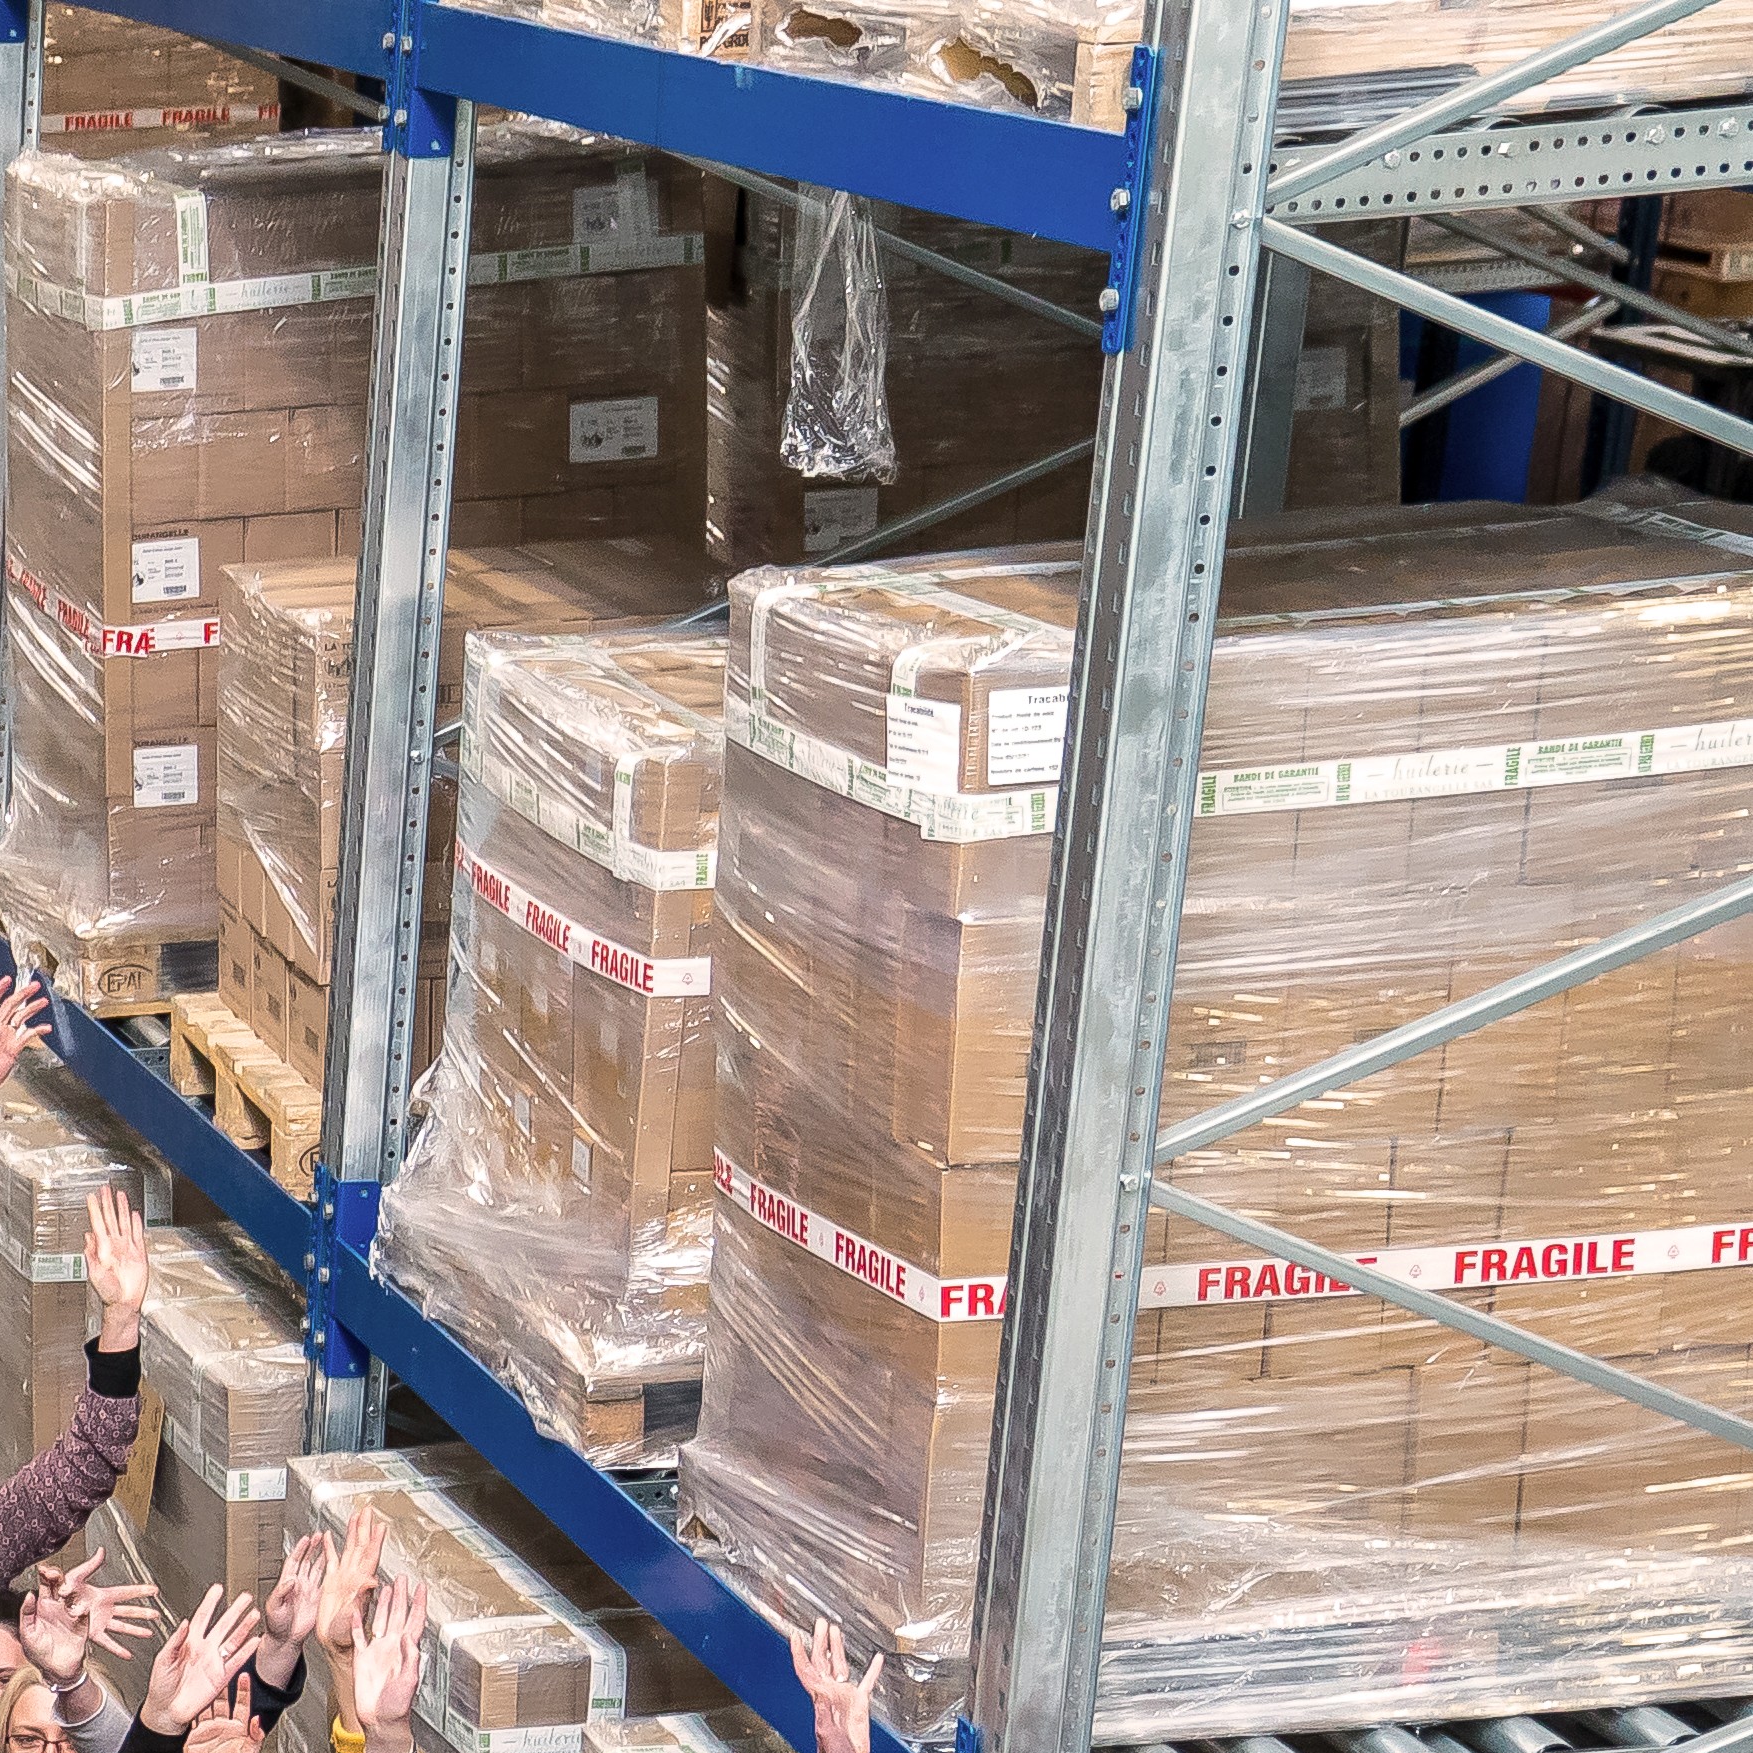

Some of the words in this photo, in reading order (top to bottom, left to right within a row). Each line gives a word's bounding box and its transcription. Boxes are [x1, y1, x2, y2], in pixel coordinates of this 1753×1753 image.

[1200, 775, 1217, 815] FRAGILE
[1504, 746, 1521, 786] FRAGILE
[471, 860, 511, 914] FRAGILE
[525, 900, 571, 955] FRAGILE
[591, 939, 654, 993] FRAGILE
[749, 1181, 809, 1247] FRAGILE
[835, 1230, 907, 1300] FRAGILE
[1454, 1238, 1636, 1284] FRAGILE
